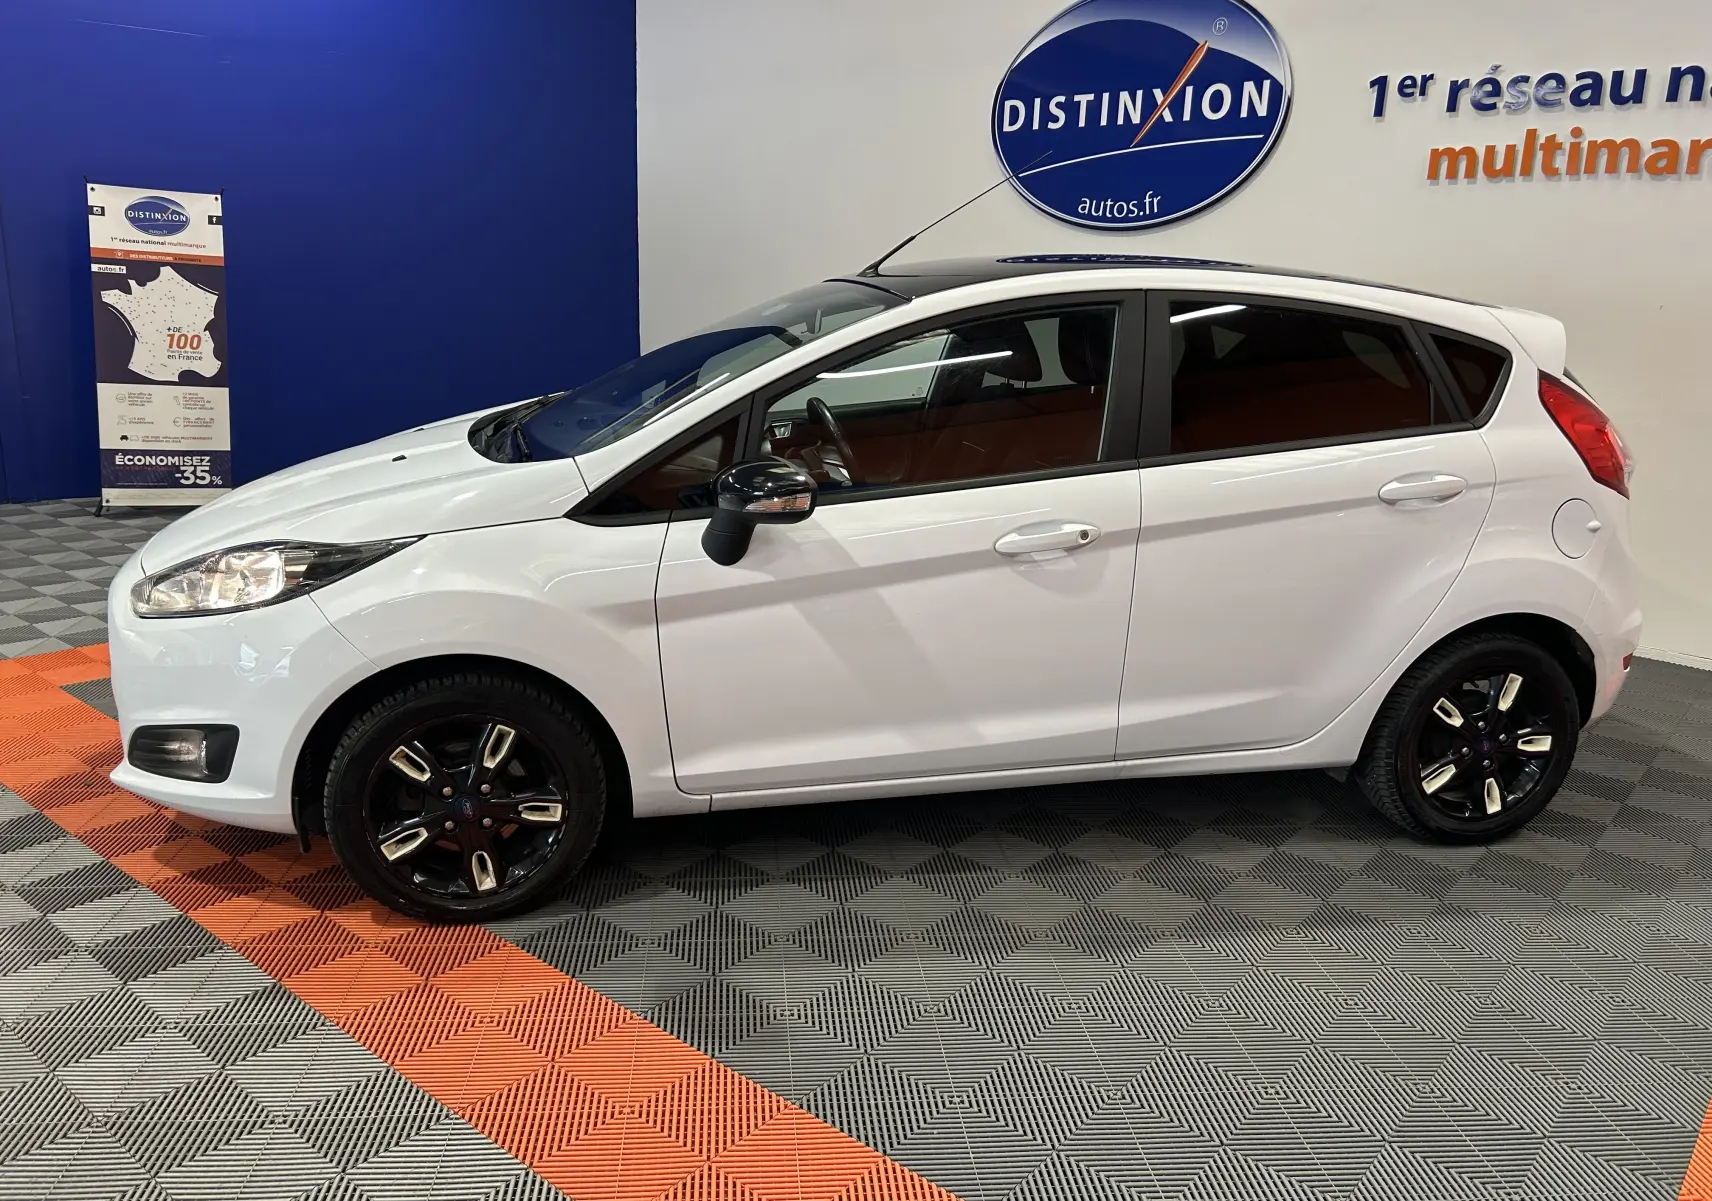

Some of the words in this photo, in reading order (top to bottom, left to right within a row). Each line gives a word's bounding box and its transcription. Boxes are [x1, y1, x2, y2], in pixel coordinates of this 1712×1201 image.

[1368, 72, 1435, 118] 1er
[1445, 63, 1648, 113] réseau
[1665, 65, 1712, 103] n
[1002, 76, 1271, 137] DISTINXION
[1427, 126, 1712, 181] multimar
[1078, 190, 1161, 218] autos.fr
[127, 209, 187, 222] DISTINXION
[167, 241, 207, 249] multimarque
[97, 265, 125, 273] autos.fr
[167, 333, 202, 350] 100
[178, 353, 203, 361] France
[115, 453, 211, 466] ÉCONOMISEZ
